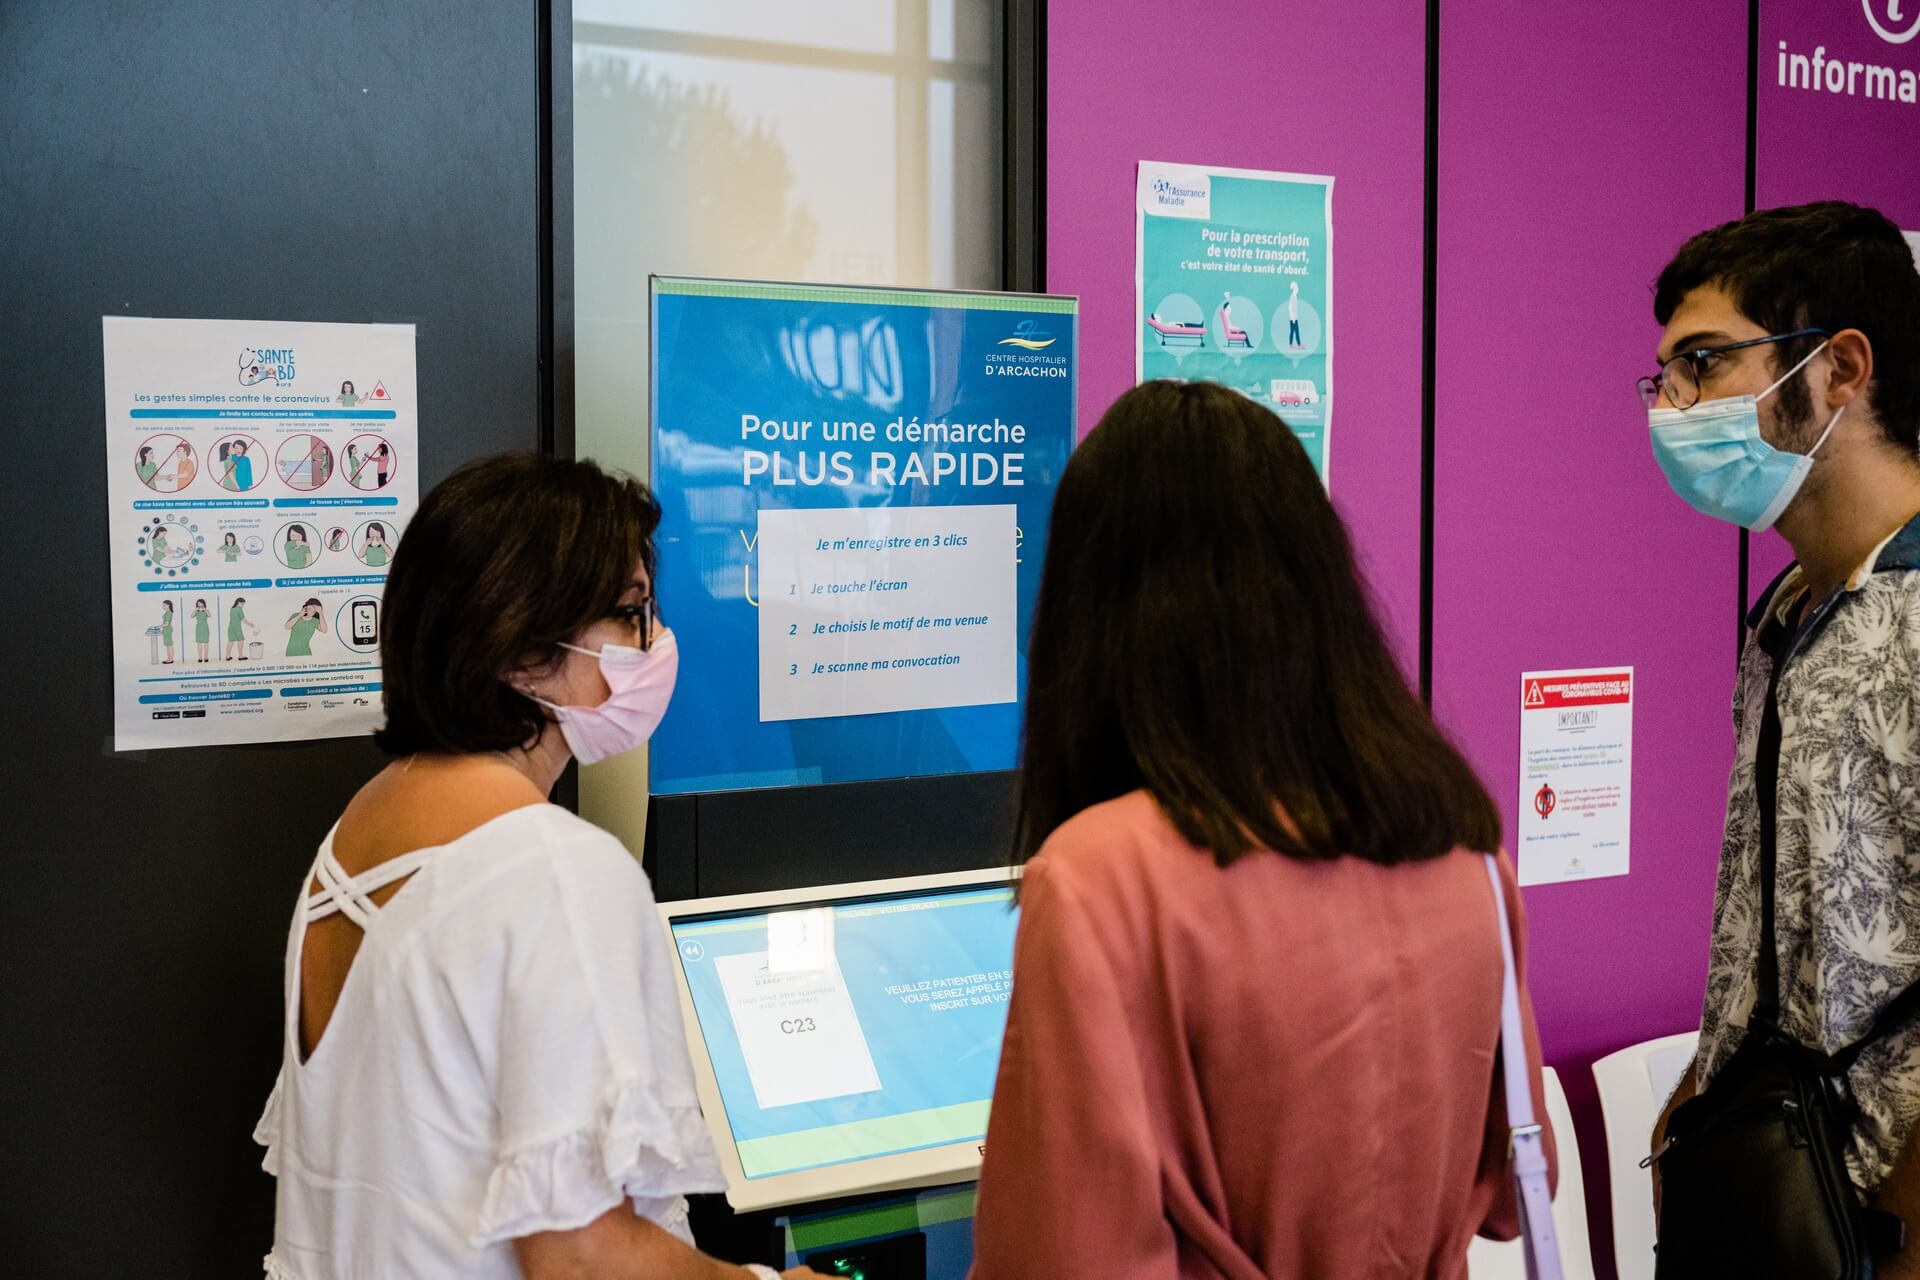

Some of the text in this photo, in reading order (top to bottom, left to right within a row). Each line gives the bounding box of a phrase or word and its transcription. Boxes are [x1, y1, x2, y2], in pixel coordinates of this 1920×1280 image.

[1778, 40, 1920, 104] informa
[1169, 186, 1206, 198] l'Assurance
[1158, 196, 1185, 206] Maladie
[1201, 228, 1309, 248] Pour la prescription
[1208, 244, 1309, 264] de votre transport,
[1181, 260, 1309, 275] c'est votre état de santé d'abord.
[257, 347, 295, 365] SANTÉ
[985, 354, 1066, 364] CENTRE HOSPITALIER
[277, 365, 296, 380] BD
[985, 365, 1067, 378] D'ARCACHON
[135, 393, 330, 404] Les gestes simples contre le coronavirus
[741, 414, 1026, 443] Pour une démarche
[743, 451, 1024, 486] PLUS RAPIDE
[816, 534, 968, 551] Je m'enregistre en 3 clics
[789, 579, 908, 595] 1 Je touche l'écran
[360, 624, 371, 634] 15
[789, 615, 988, 636] 2 Je choisis le motif de ma venue
[790, 654, 960, 675] 3 Je scanne ma convocation
[1558, 710, 1598, 727] IMPORTANT!
[885, 970, 1014, 995] VEUILLEZ PATIENTER EN S
[900, 980, 1014, 1004] VOUS SEREZ APPELÉ P
[930, 998, 969, 1012] INSCRIT
[971, 995, 992, 1006] SUR
[780, 1017, 816, 1034] C23
